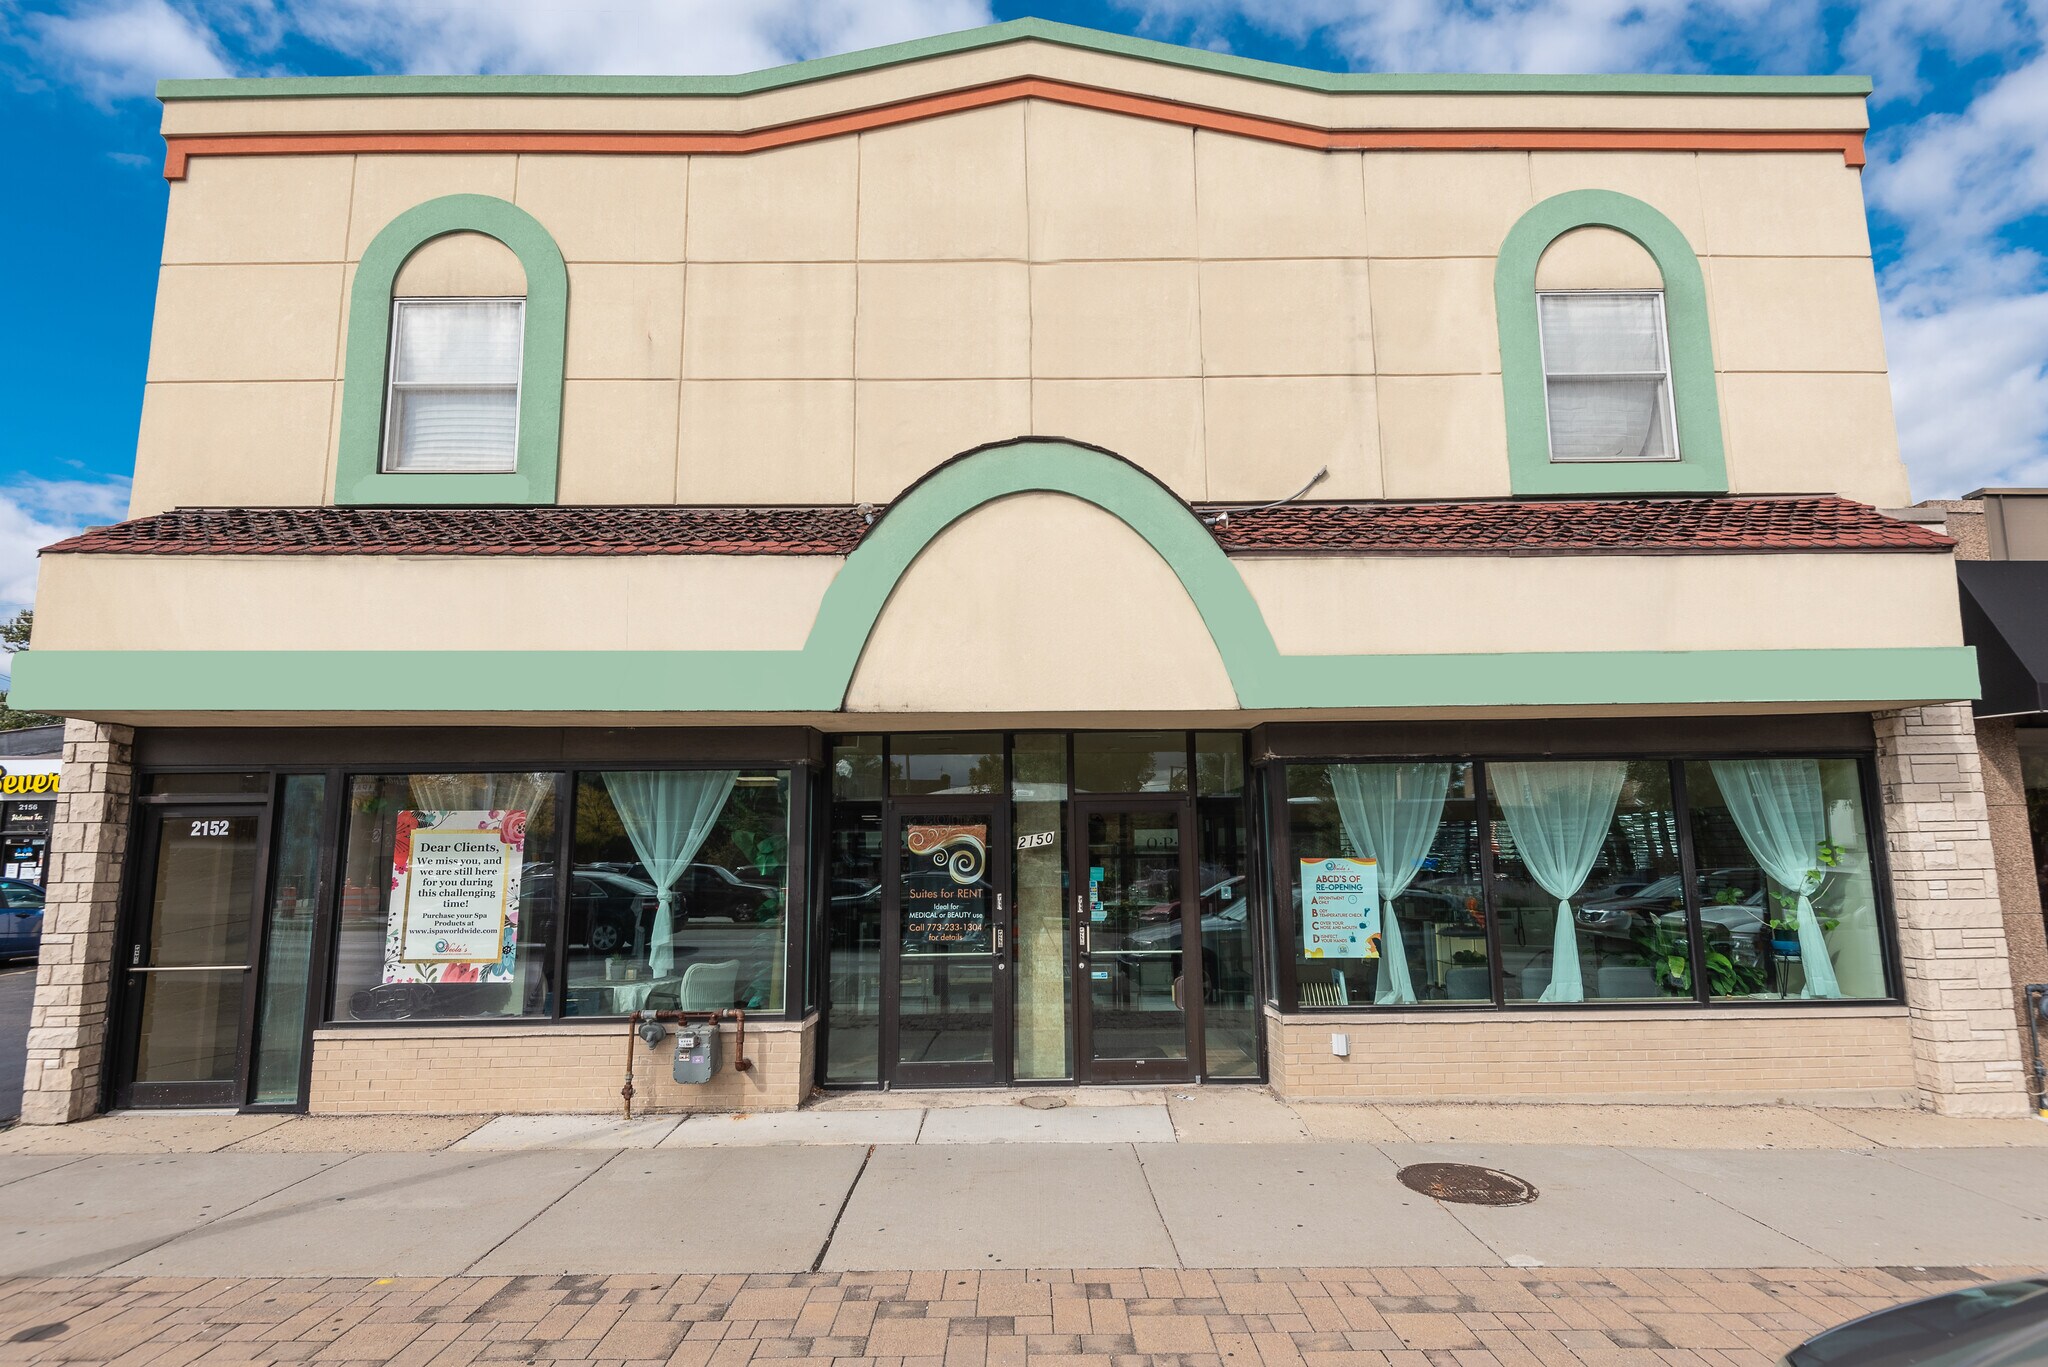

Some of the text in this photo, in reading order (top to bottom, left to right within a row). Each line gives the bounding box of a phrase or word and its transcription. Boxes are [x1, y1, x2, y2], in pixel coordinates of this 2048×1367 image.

[190, 820, 230, 837] 2152
[1018, 832, 1053, 848] 2150
[420, 842, 499, 854] Dear Clients,
[417, 857, 502, 866] We miss you, and
[453, 867, 473, 875] still
[475, 867, 498, 875] here
[422, 878, 493, 888] for you during
[1316, 875, 1361, 883] ABCD'S OF
[1316, 883, 1363, 891] RE-OPENING
[418, 889, 496, 898] this challenging
[909, 888, 983, 899] Suites for RENT
[443, 899, 469, 908] time!
[473, 912, 488, 920] Spa
[909, 923, 982, 931] Call 773-233-1304
[409, 928, 498, 936] www.ispaworldwide.com
